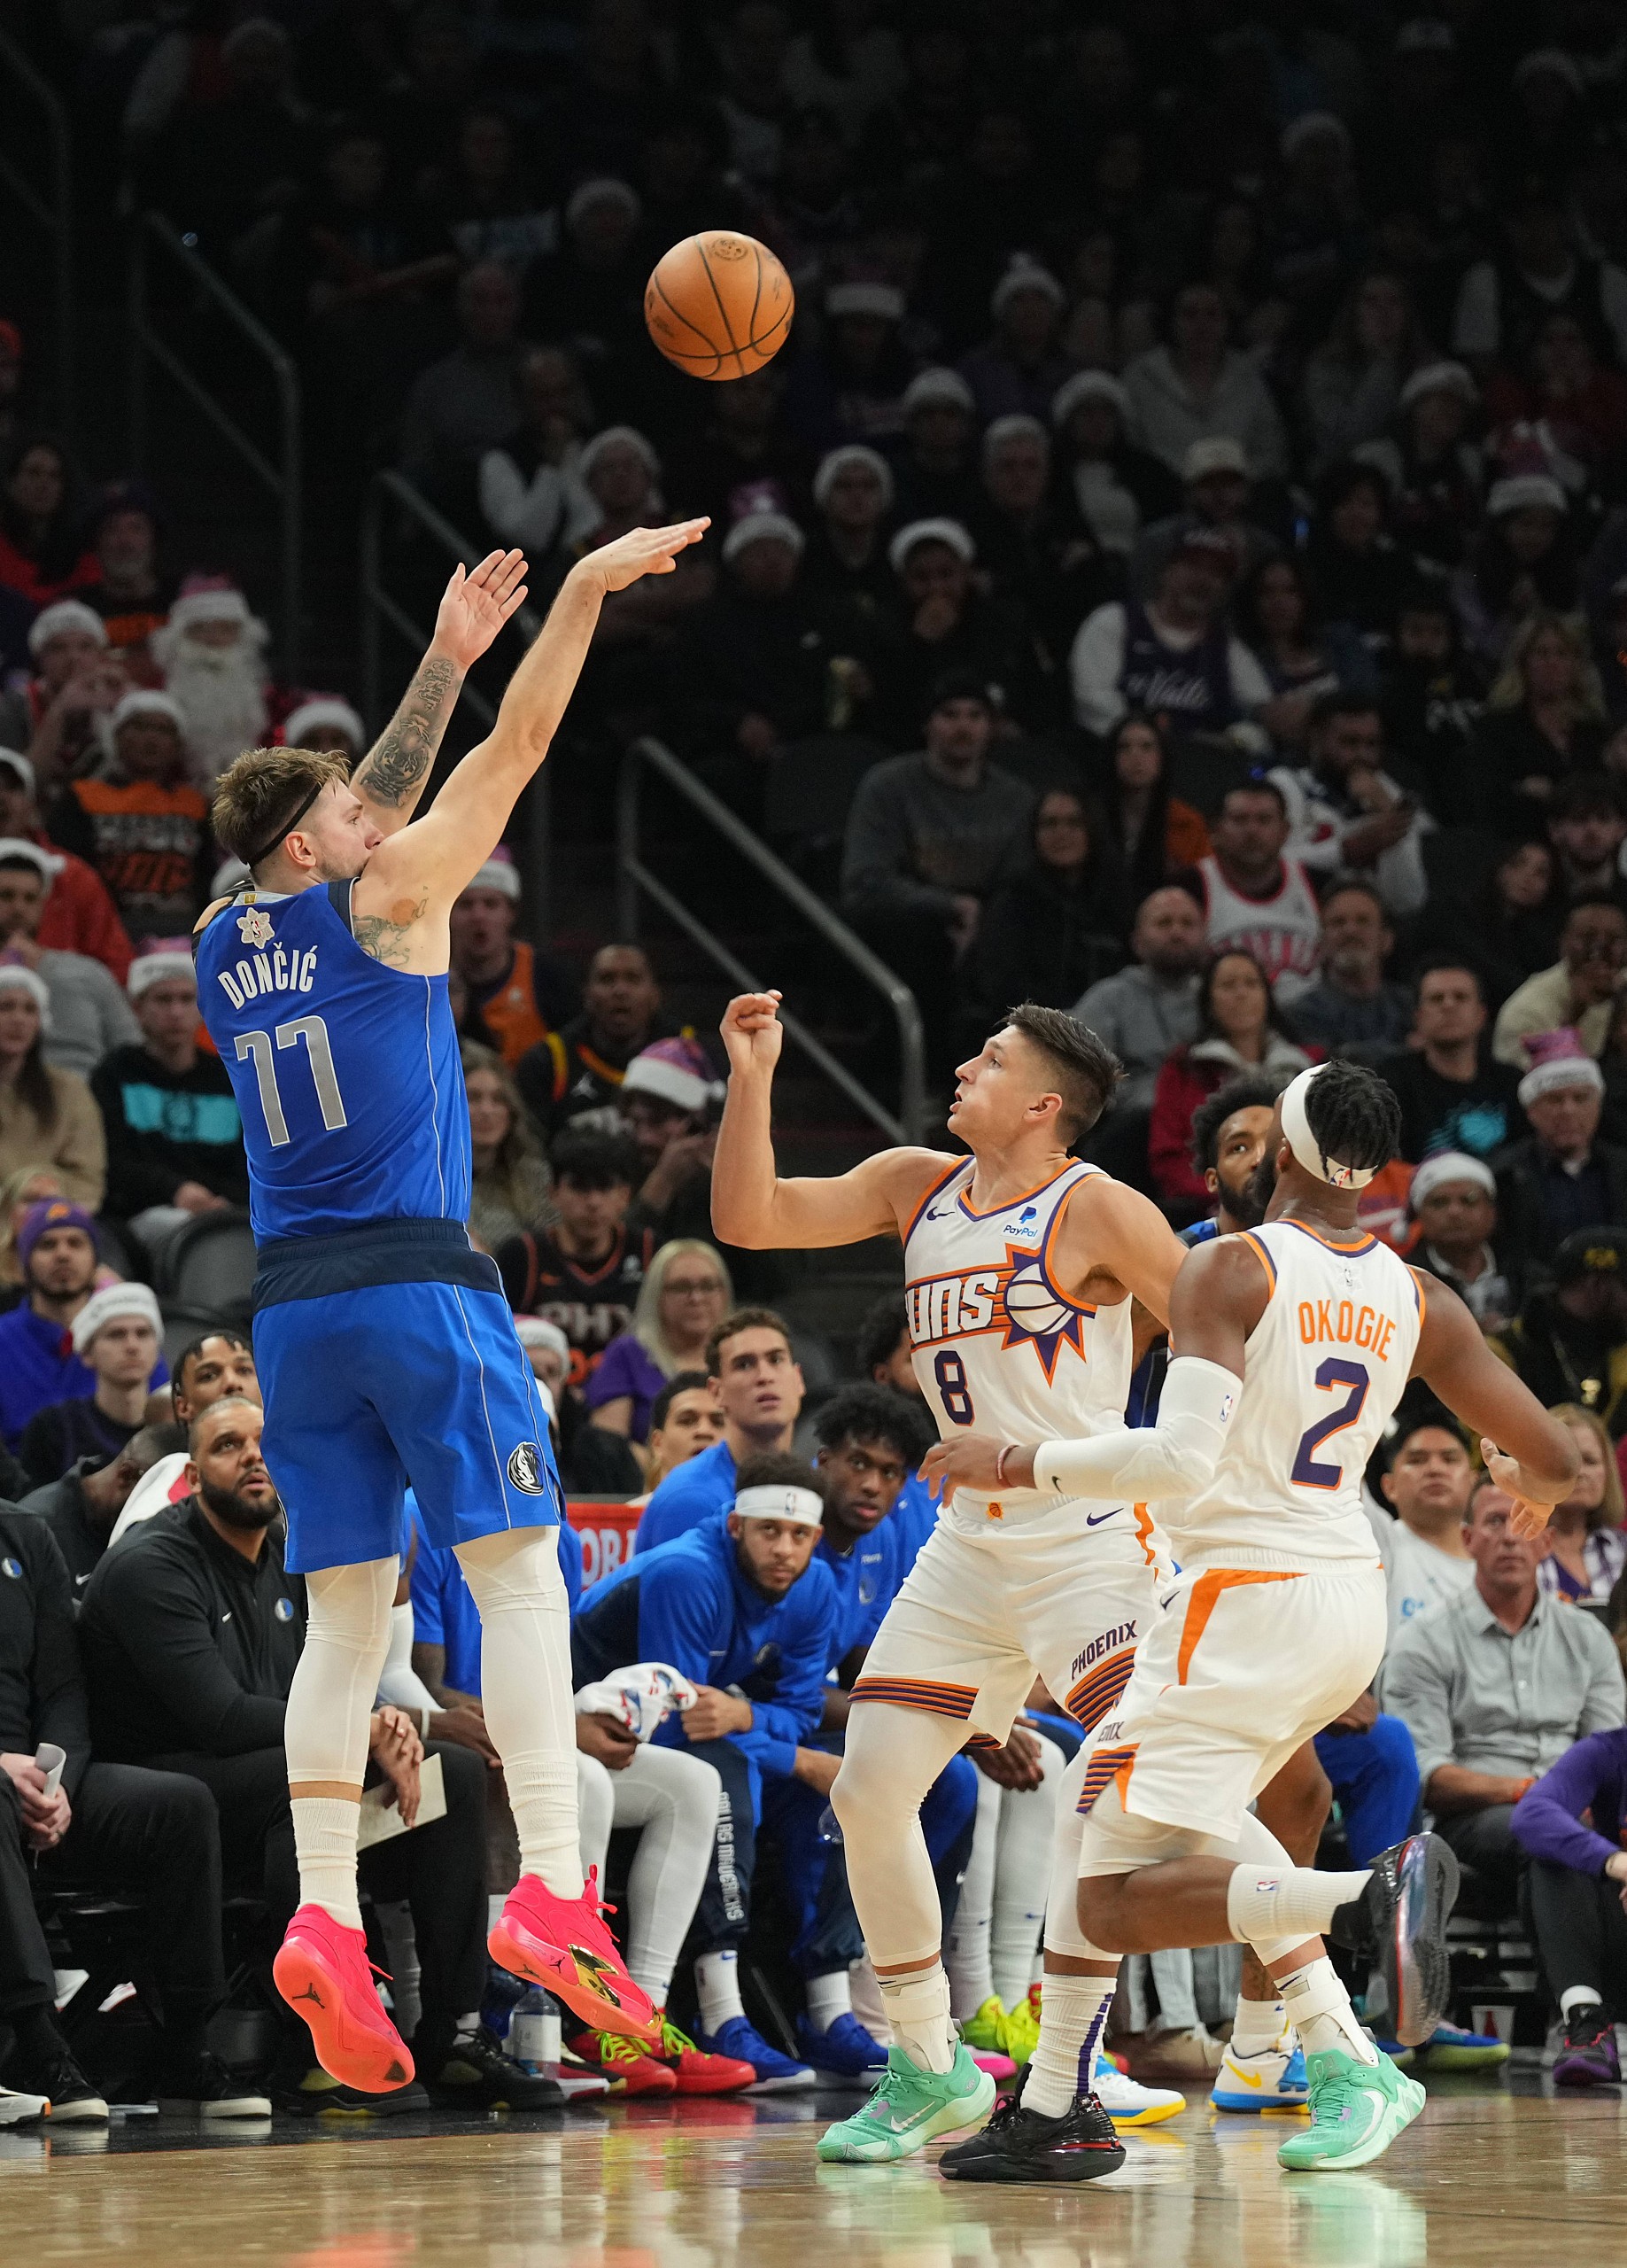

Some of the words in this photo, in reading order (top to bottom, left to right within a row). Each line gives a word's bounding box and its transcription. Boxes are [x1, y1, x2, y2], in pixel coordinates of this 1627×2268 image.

[217, 941, 319, 1011] DONČIĆ
[233, 1014, 348, 1147] 77
[1003, 1224, 1039, 1238] PayPal
[905, 1272, 999, 1345] UNS
[1298, 1299, 1397, 1363] OKOGIE
[934, 1350, 975, 1427] 8
[1290, 1356, 1371, 1491] 2
[1071, 1619, 1138, 1682] PHOENIX
